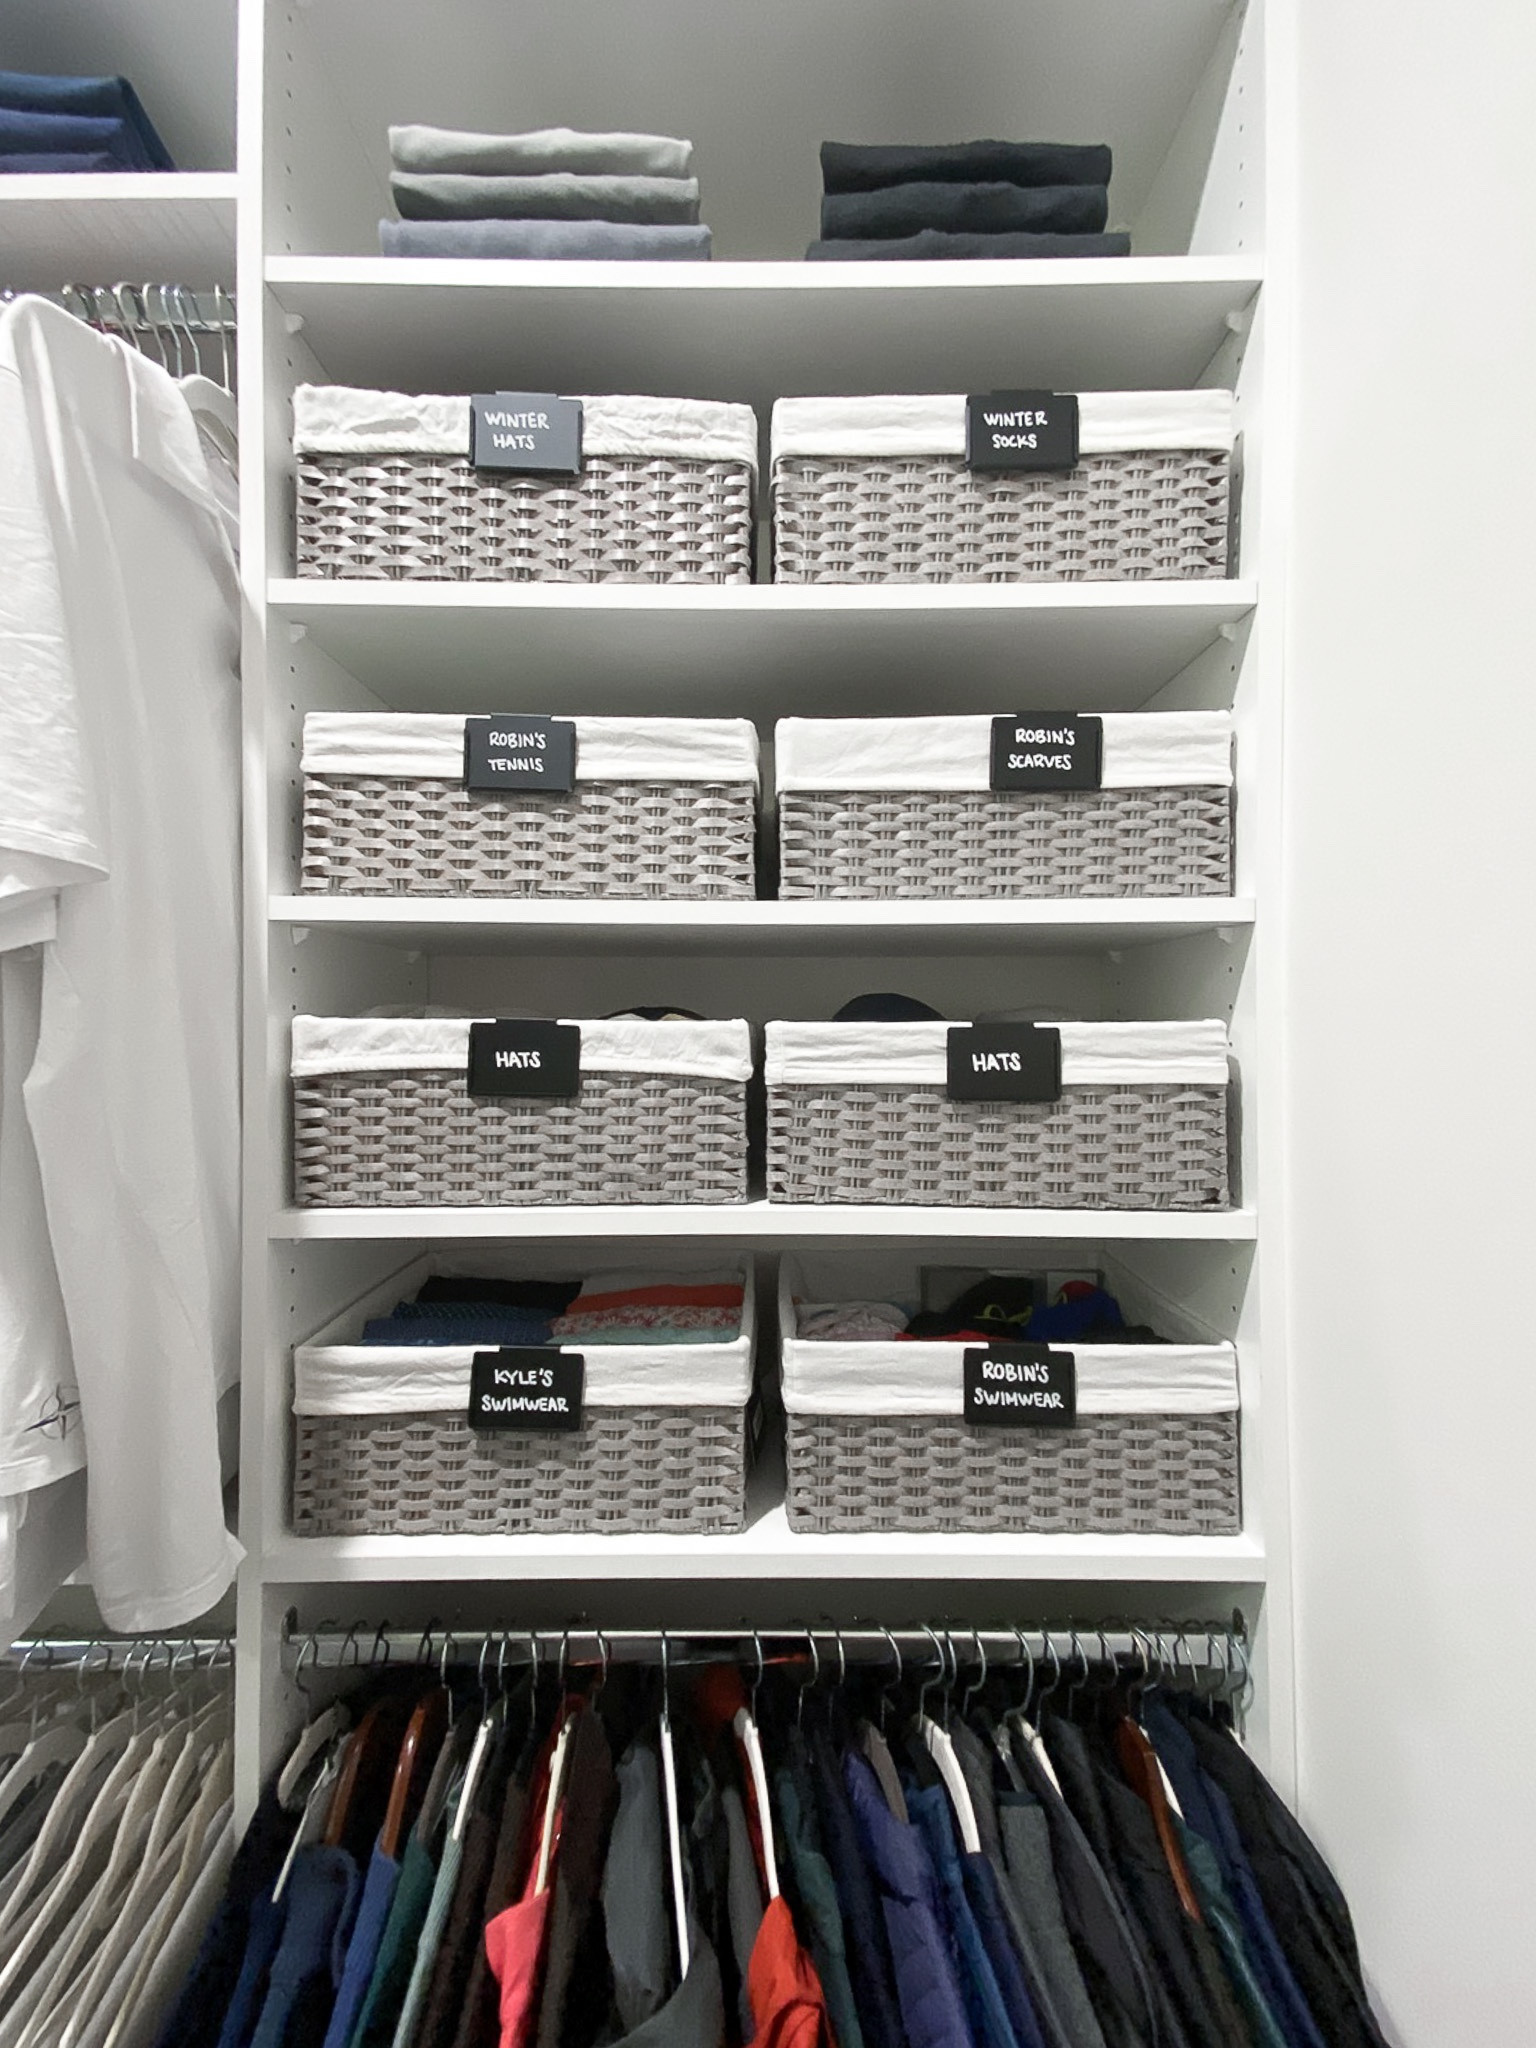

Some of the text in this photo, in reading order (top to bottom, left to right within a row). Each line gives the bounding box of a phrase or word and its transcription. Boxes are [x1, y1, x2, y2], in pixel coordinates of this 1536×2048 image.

[484, 411, 550, 430] WINTER
[983, 410, 1049, 428] WINTER
[493, 432, 536, 451] HATS
[991, 432, 1038, 449] SOCKS
[488, 730, 547, 750] ROBIN'S
[1015, 727, 1076, 747] ROBIN'S
[487, 757, 545, 773] TENNIS
[1007, 753, 1072, 771] SCARVES
[495, 1050, 541, 1069] HATS
[971, 1051, 1022, 1073] HATS
[494, 1367, 554, 1387] KYLE'S
[982, 1360, 1050, 1384] ROBIN'S
[481, 1394, 569, 1413] SWIMWEAR
[973, 1387, 1065, 1409] SWIMWEAR
